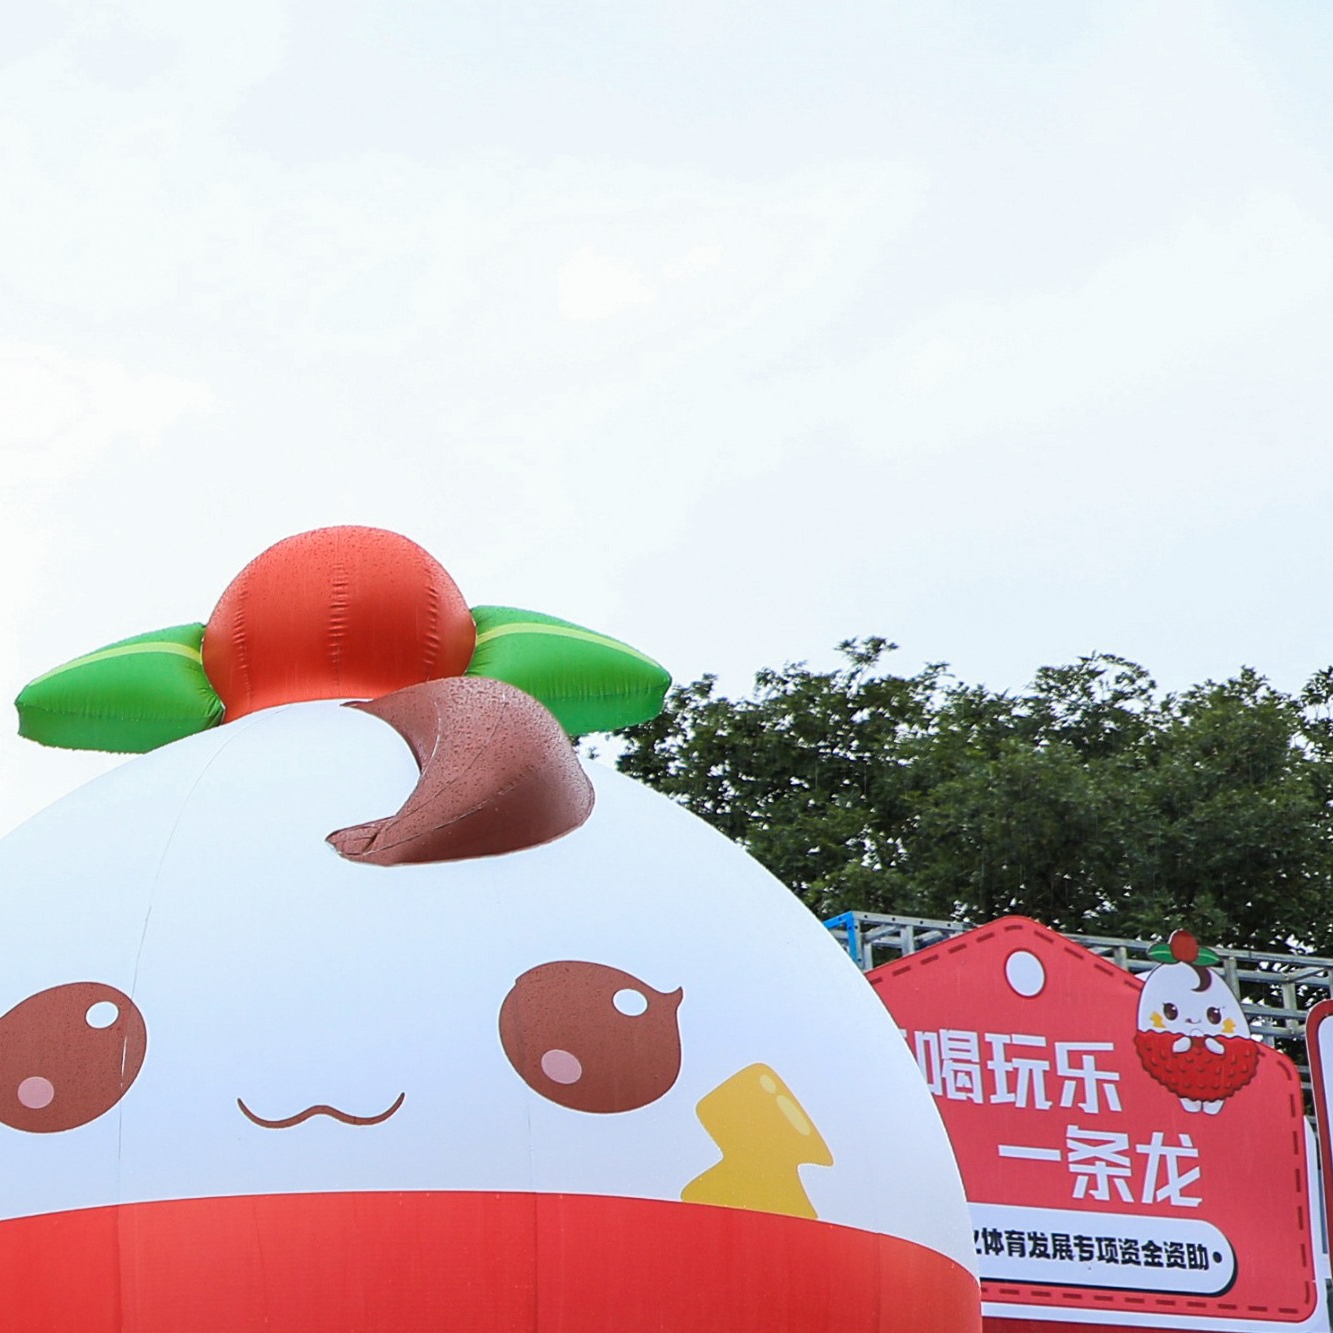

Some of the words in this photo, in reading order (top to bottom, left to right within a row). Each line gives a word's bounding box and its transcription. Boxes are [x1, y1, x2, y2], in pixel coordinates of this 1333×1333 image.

[901, 1029, 1122, 1114] 喝玩乐
[997, 1124, 1203, 1208] 一条龙
